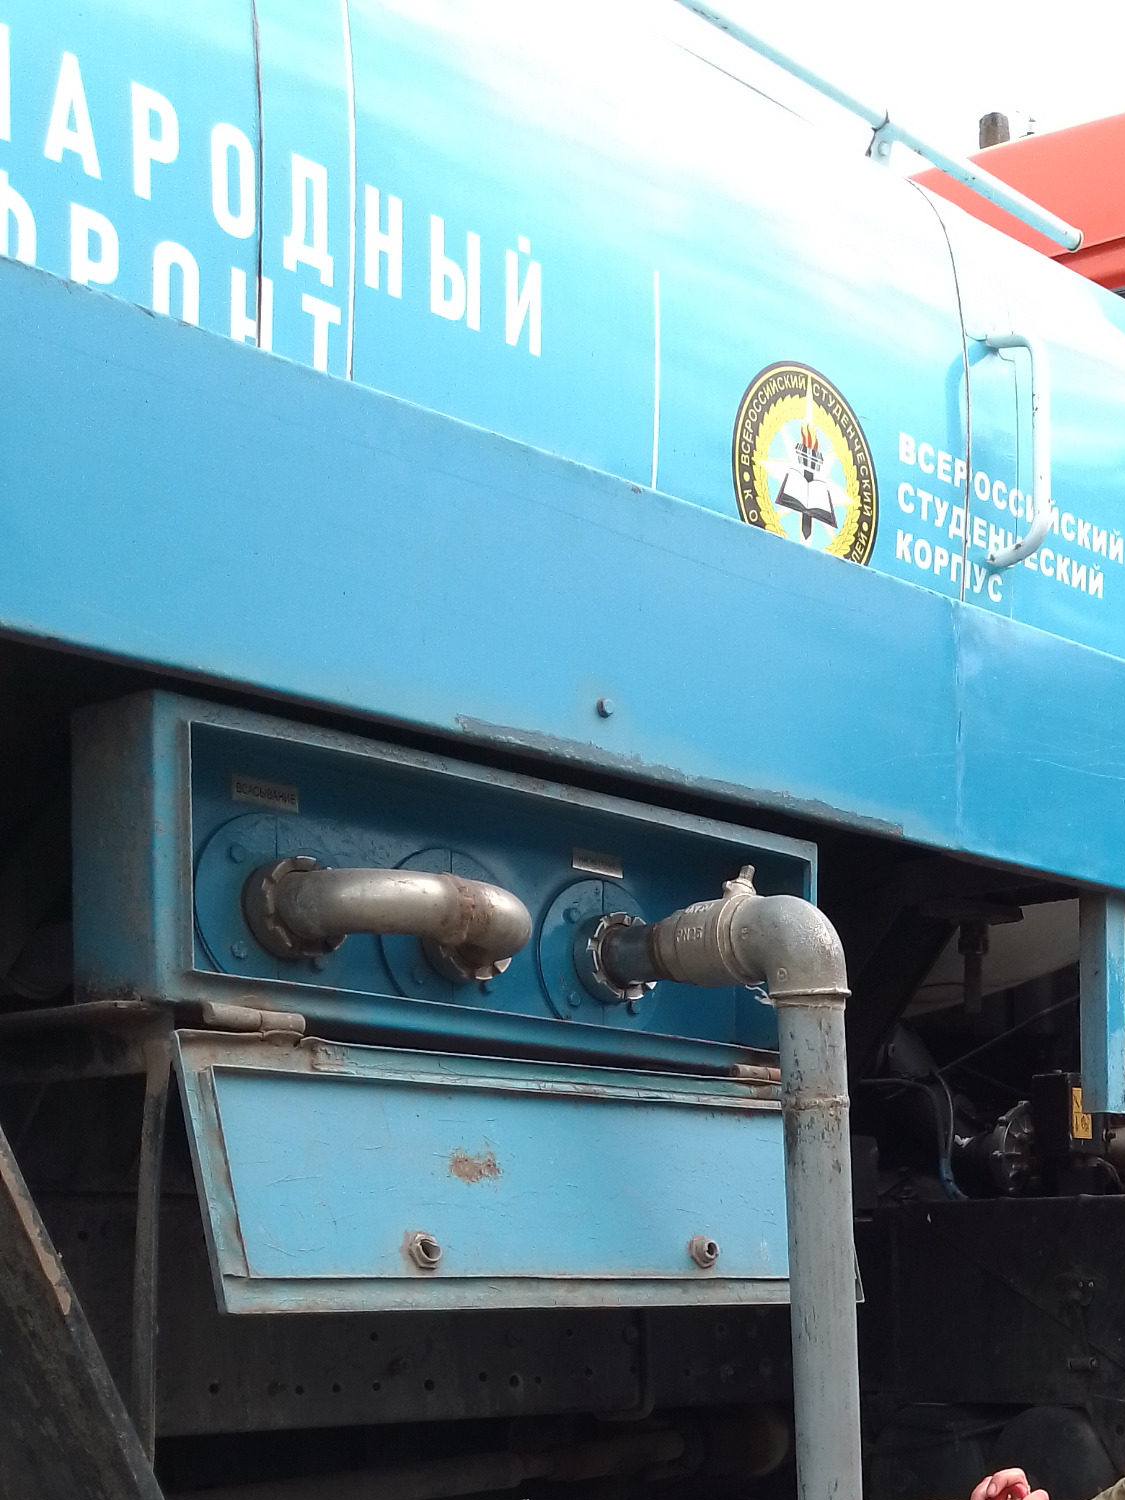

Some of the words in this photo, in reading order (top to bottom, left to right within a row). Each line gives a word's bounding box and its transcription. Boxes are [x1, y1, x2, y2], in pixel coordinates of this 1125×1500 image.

[740, 374, 806, 466] ВСЕРОССИЙСКИЙ
[812, 383, 873, 517] СТУДЕНЧЕСКИЙ
[895, 529, 1003, 603] КОРПУС
[236, 782, 296, 805] ВСАСЫВАНИЕ
